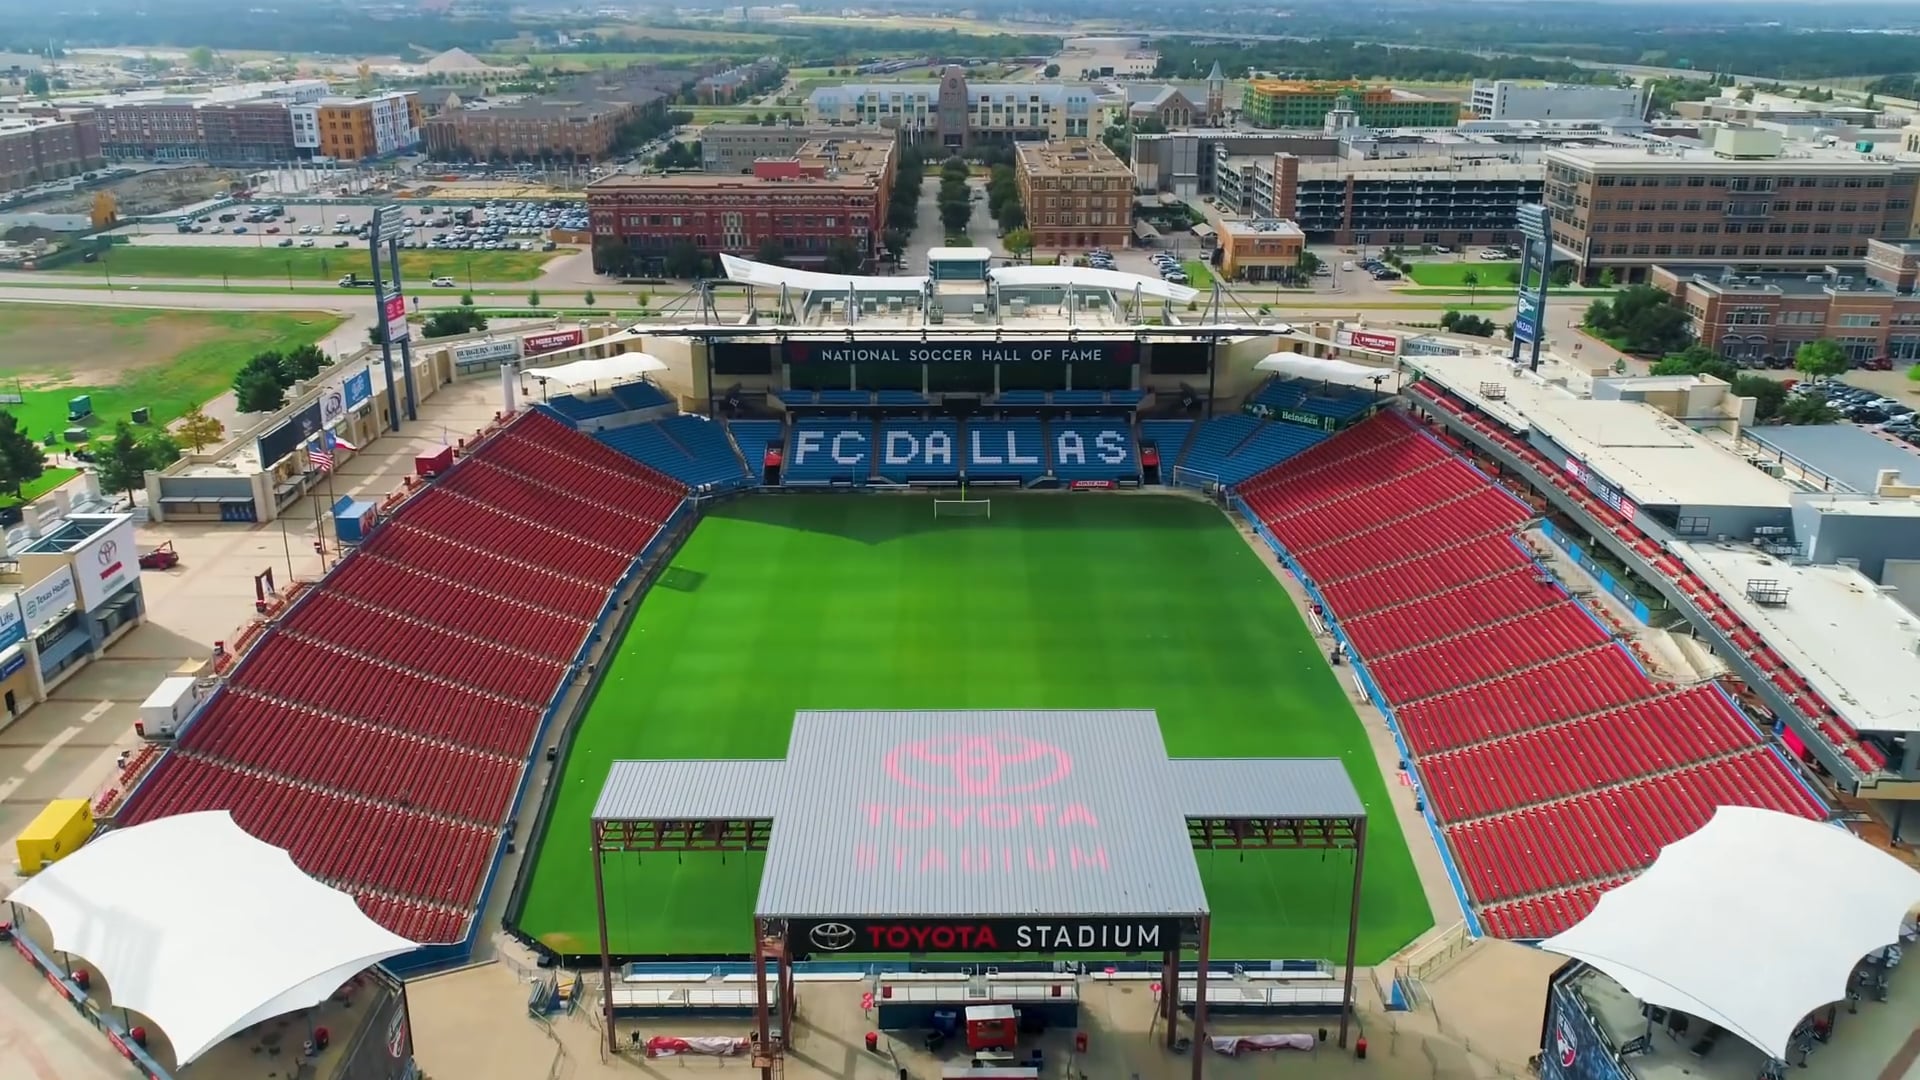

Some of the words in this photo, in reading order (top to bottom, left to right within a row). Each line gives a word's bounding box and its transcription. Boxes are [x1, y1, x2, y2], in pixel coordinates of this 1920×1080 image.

[456, 346, 489, 357] BURGERS
[494, 343, 513, 351] MORE
[822, 349, 900, 361] NATIONAL
[910, 349, 972, 361] SOCCER
[982, 349, 1021, 361] HALL
[1031, 349, 1052, 361] OF
[1061, 349, 1102, 361] FAME
[1422, 344, 1440, 353] STREET
[1282, 410, 1319, 425] Heineken
[795, 431, 865, 465] FC
[886, 431, 1127, 465] DALLAS
[36, 591, 52, 604] Texas
[52, 578, 70, 594] Health
[0, 611, 14, 626] Life
[861, 803, 1099, 829] TOYOTA
[855, 844, 1110, 873] STADIUM
[866, 926, 998, 948] TOYOTA
[1016, 925, 1160, 948] STADIUM
